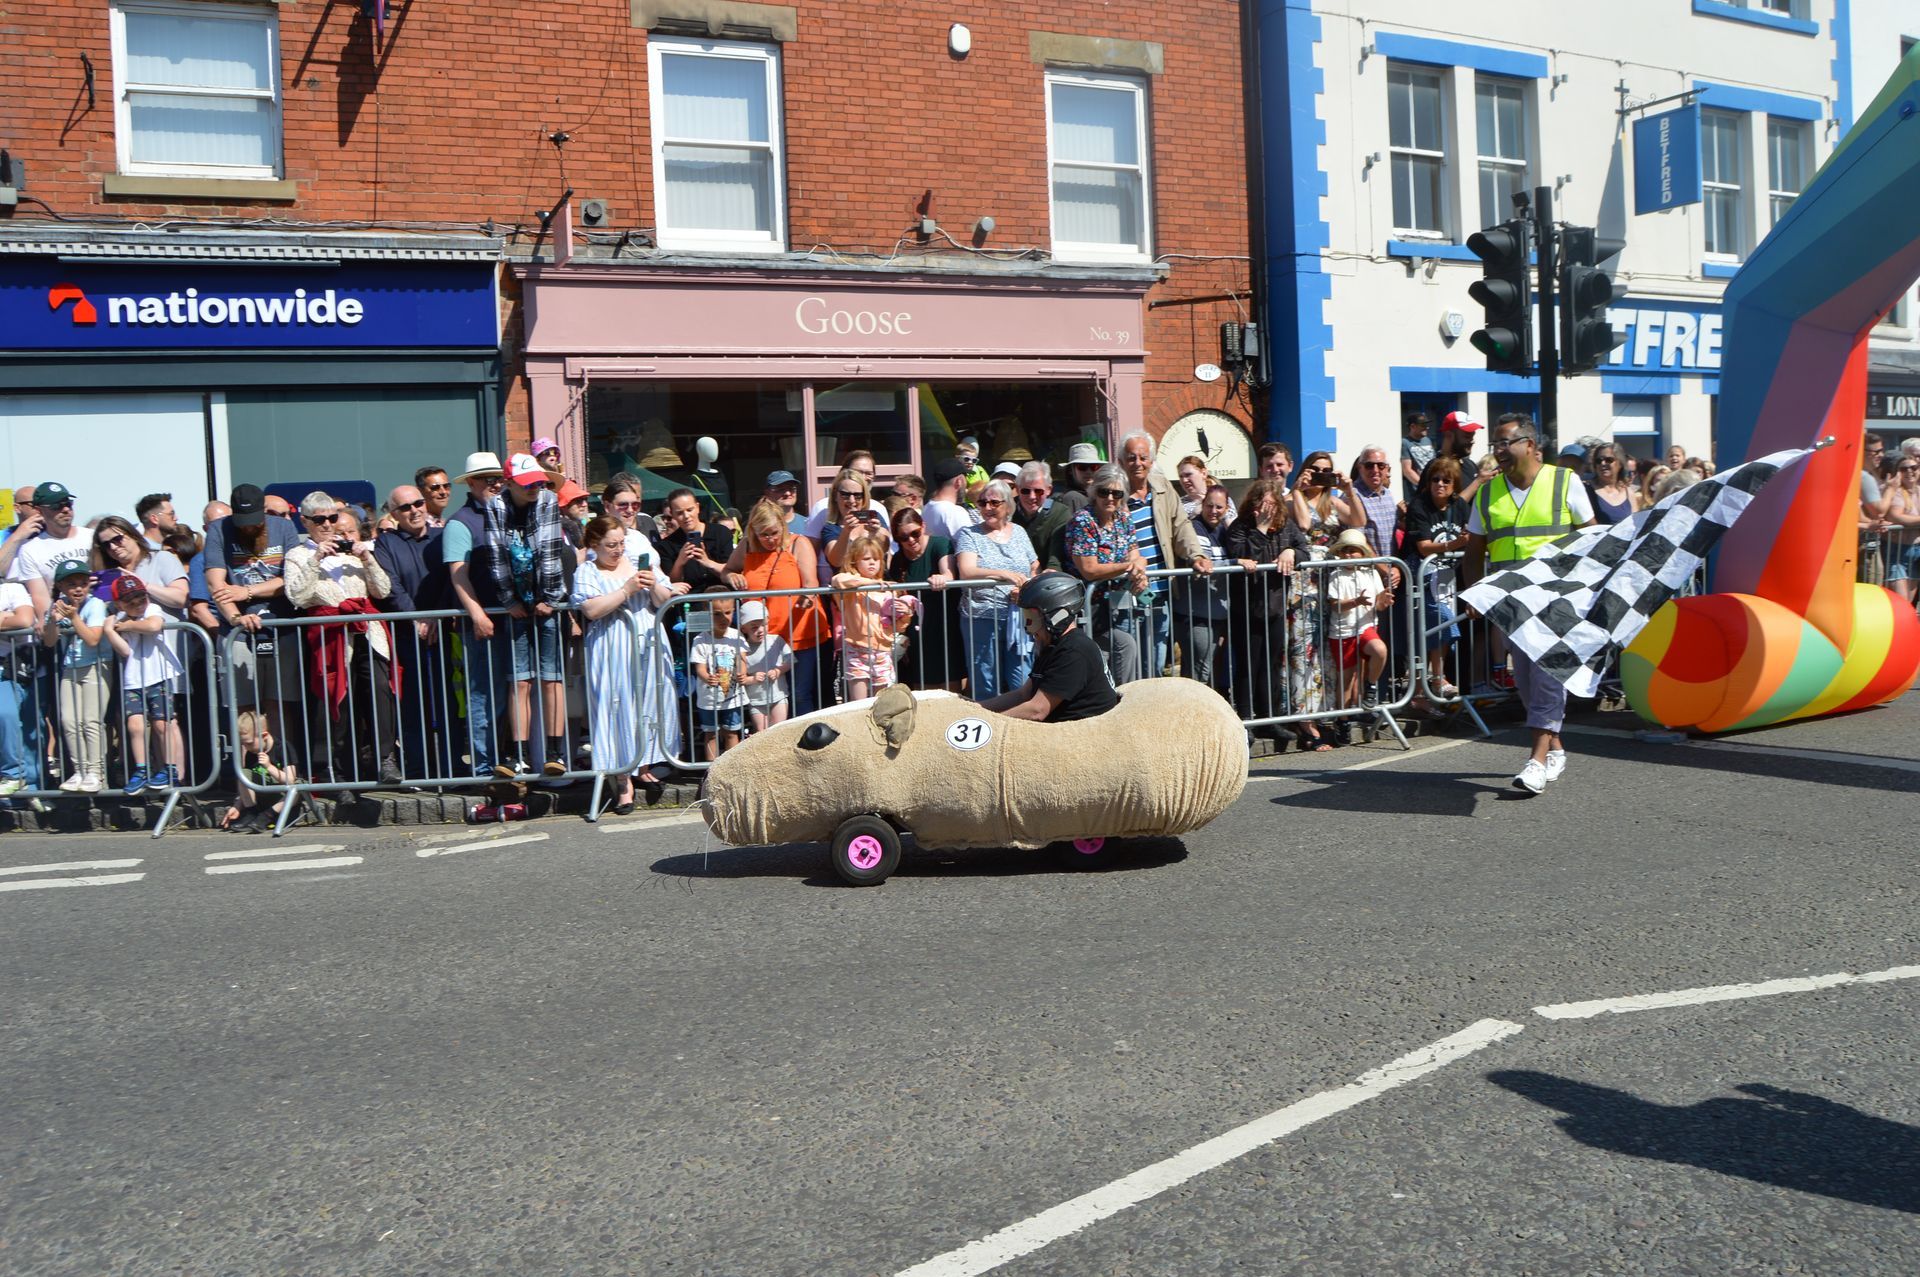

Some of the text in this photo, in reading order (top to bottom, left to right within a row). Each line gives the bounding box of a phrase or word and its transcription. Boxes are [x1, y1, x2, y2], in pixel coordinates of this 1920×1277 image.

[1660, 118, 1672, 204] BETFRED
[108, 288, 364, 323] nationwide
[795, 297, 913, 335] Goose
[1089, 327, 1130, 344] No. 39
[1532, 304, 1723, 369] TFRE
[1887, 396, 1920, 416] LON
[954, 723, 982, 743] 31
